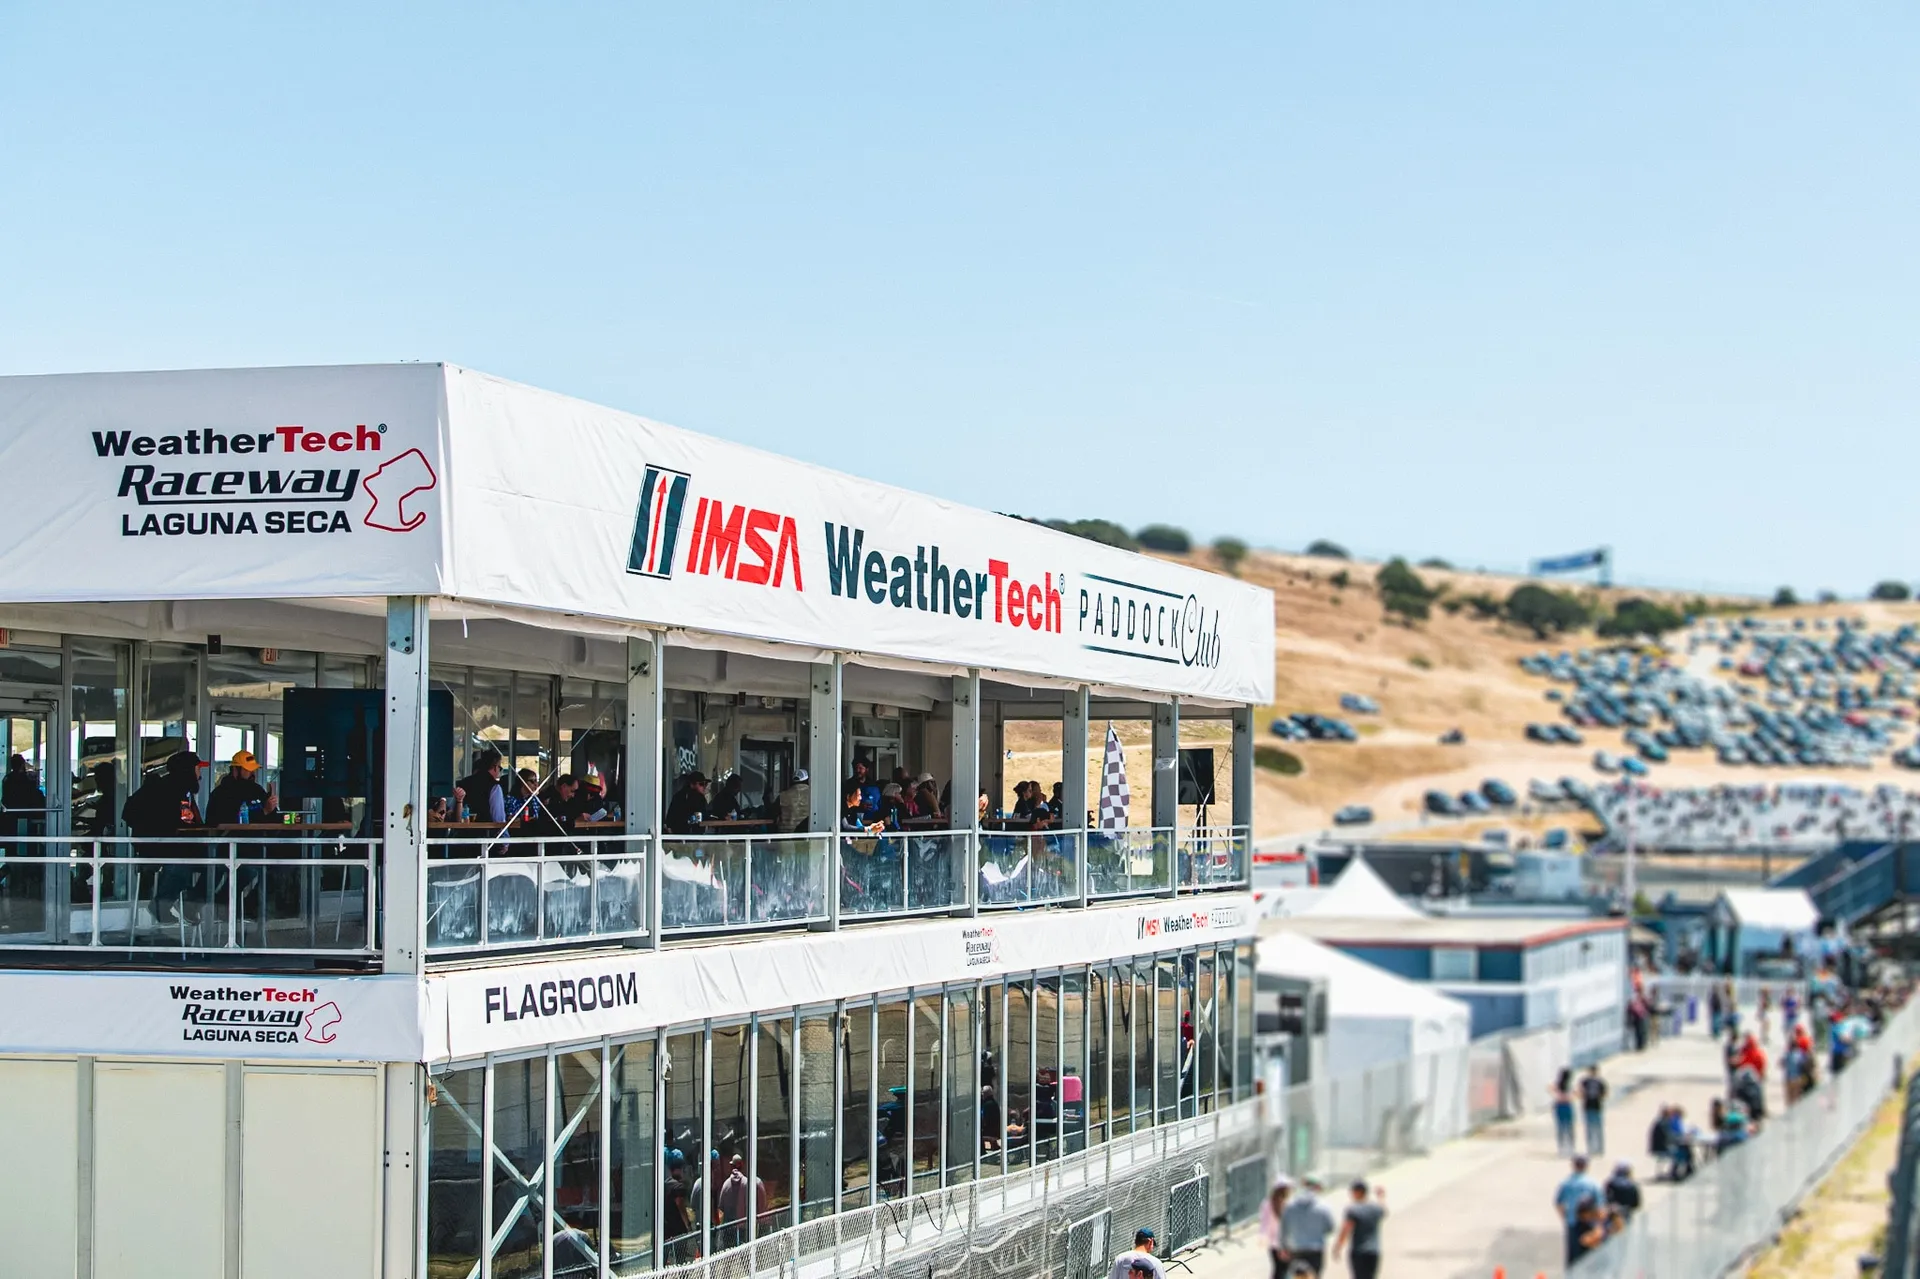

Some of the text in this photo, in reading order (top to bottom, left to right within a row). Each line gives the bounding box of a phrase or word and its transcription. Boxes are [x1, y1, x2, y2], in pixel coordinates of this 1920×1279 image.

[117, 465, 360, 505] Raceway
[122, 511, 352, 536] LAGUNA SECA
[686, 497, 803, 592] IMSA
[1079, 588, 1179, 649] PADDOCK
[1181, 593, 1220, 669] Club
[1163, 912, 1208, 933] WeatherTech
[485, 972, 638, 1024] FLAGROOM
[182, 1004, 304, 1027] Raceway
[184, 1029, 298, 1043] LAGUNA SECA
